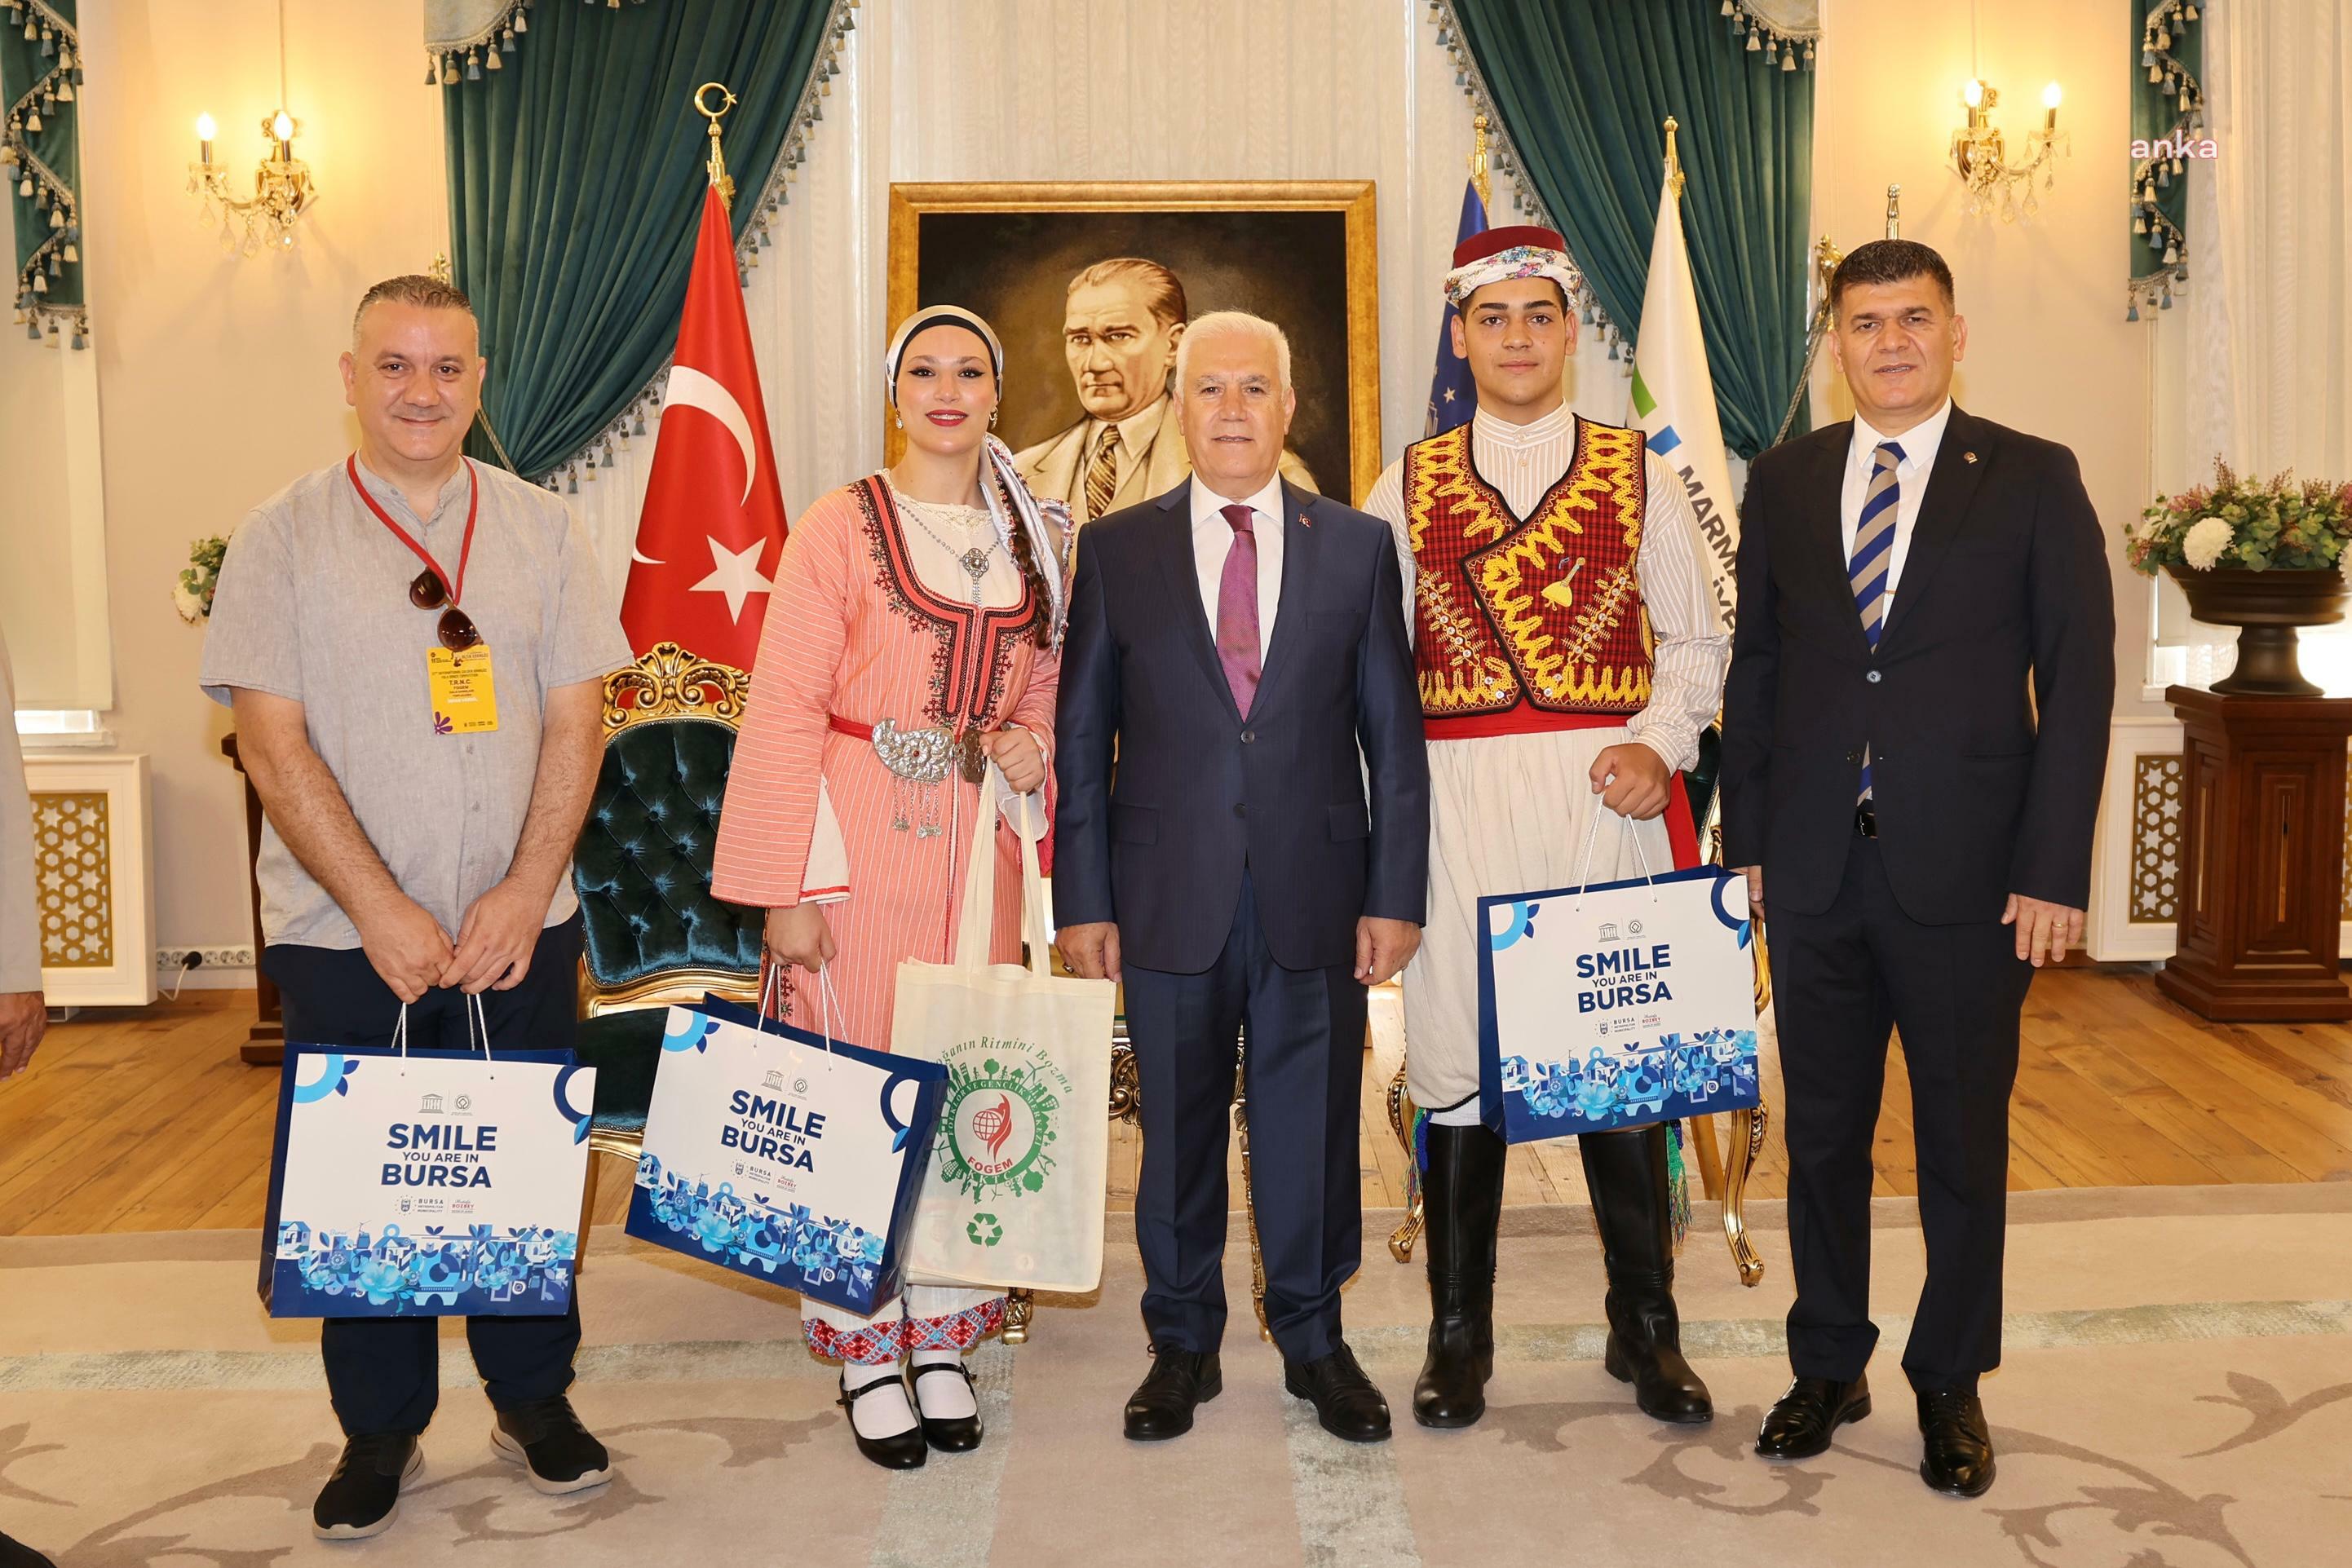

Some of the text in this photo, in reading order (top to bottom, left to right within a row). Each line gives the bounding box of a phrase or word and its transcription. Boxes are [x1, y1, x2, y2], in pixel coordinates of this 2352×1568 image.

[1576, 944, 1671, 978] SMILE
[1592, 971, 1657, 987] YOU ARE IN
[1577, 981, 1673, 1014] BURSA
[1613, 1017, 1635, 1025] BURSA
[981, 1036, 1035, 1053] Ritmini
[1036, 1049, 1073, 1094] Bozma
[729, 1089, 826, 1139] SMILE
[948, 1089, 967, 1136] FOLKLOR
[966, 1081, 979, 1092] VE
[387, 1123, 497, 1151] SMILE
[741, 1118, 806, 1146] YOU ARE IN
[403, 1151, 479, 1163] YOU ARE IN
[720, 1124, 814, 1173] BURSA
[381, 1164, 492, 1188] BURSA
[749, 1166, 771, 1177] BURSA
[967, 1156, 1014, 1174] FOGEM
[967, 1170, 1011, 1184] KKTC
